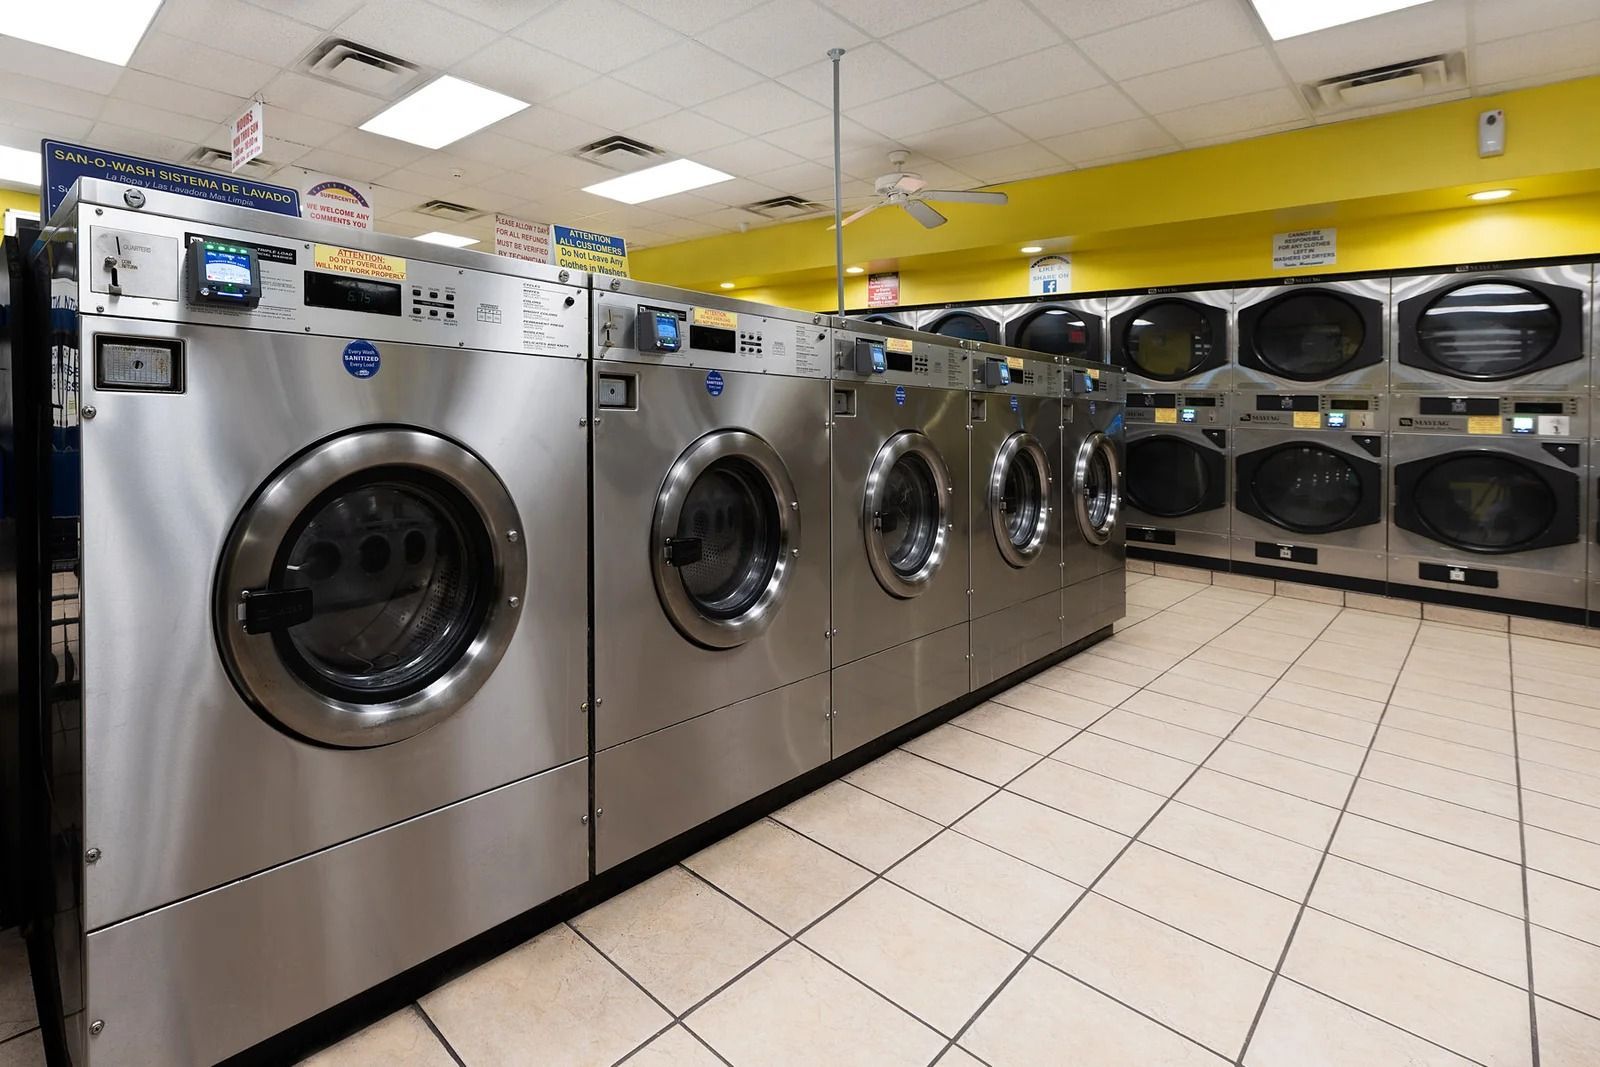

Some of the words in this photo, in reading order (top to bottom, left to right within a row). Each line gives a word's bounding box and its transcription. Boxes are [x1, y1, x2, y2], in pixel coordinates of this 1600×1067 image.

[54, 149, 156, 178] SAN-O-WASH
[159, 170, 219, 190] SISTEMA
[222, 182, 240, 194] DE
[242, 186, 291, 204] LAVADO
[105, 172, 117, 181] La
[119, 175, 143, 186] Ropa
[145, 180, 150, 188] y
[152, 181, 168, 192] Las
[169, 185, 208, 198] Lavadora
[208, 191, 226, 201] Mas
[319, 191, 359, 205] SUPERCENTER
[306, 202, 318, 211] WE
[319, 204, 355, 218] WELCOME
[355, 213, 370, 221] ANY
[310, 212, 352, 226] COMMENTS
[352, 220, 367, 229] YOU
[495, 214, 515, 228] PLEASE
[515, 221, 533, 232] ALLOW
[537, 225, 550, 236] DAYS
[496, 228, 508, 237] FOR
[509, 231, 520, 239] ALL
[521, 233, 549, 245] REFUNDS
[569, 229, 611, 244] ATTENTION
[496, 238, 513, 249] MUST
[514, 242, 523, 250] BE
[523, 244, 549, 256] VERIFIED
[559, 237, 573, 246] ALL
[576, 240, 623, 256] CUSTOMERS
[329, 255, 340, 263] DO
[341, 258, 355, 266] NOT
[337, 248, 385, 264] ATTENTION:
[561, 247, 572, 257] Do
[573, 250, 587, 260] Not
[588, 253, 609, 264] Leave
[610, 257, 624, 268] Any
[315, 261, 332, 269] WILL
[333, 264, 349, 272] NOT
[349, 266, 370, 275] WORK
[559, 258, 588, 272] Clothes
[589, 263, 597, 273] in
[597, 265, 628, 278] Washers
